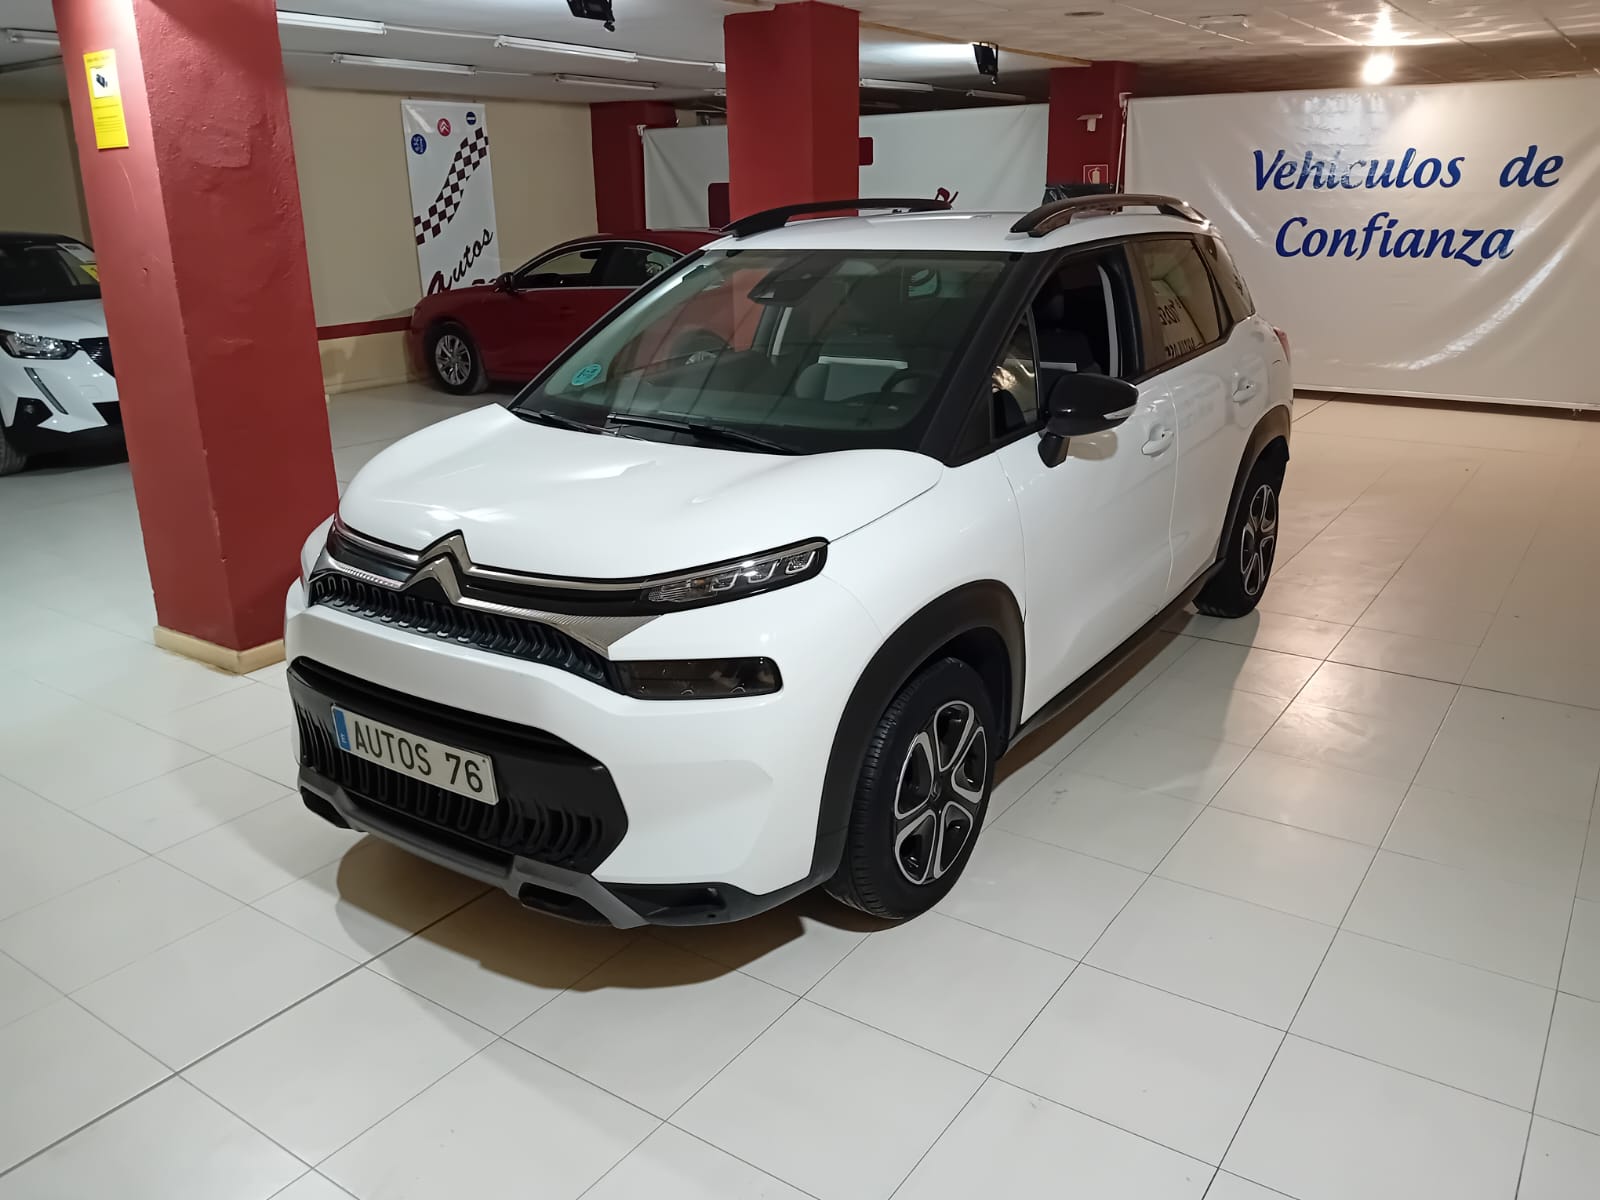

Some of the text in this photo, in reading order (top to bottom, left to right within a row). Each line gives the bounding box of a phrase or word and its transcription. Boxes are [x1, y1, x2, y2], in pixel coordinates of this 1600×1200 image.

[1499, 144, 1564, 188] de
[427, 228, 494, 297] Autos
[1275, 211, 1516, 267] Confianza
[354, 720, 483, 793] AUTOS 76
